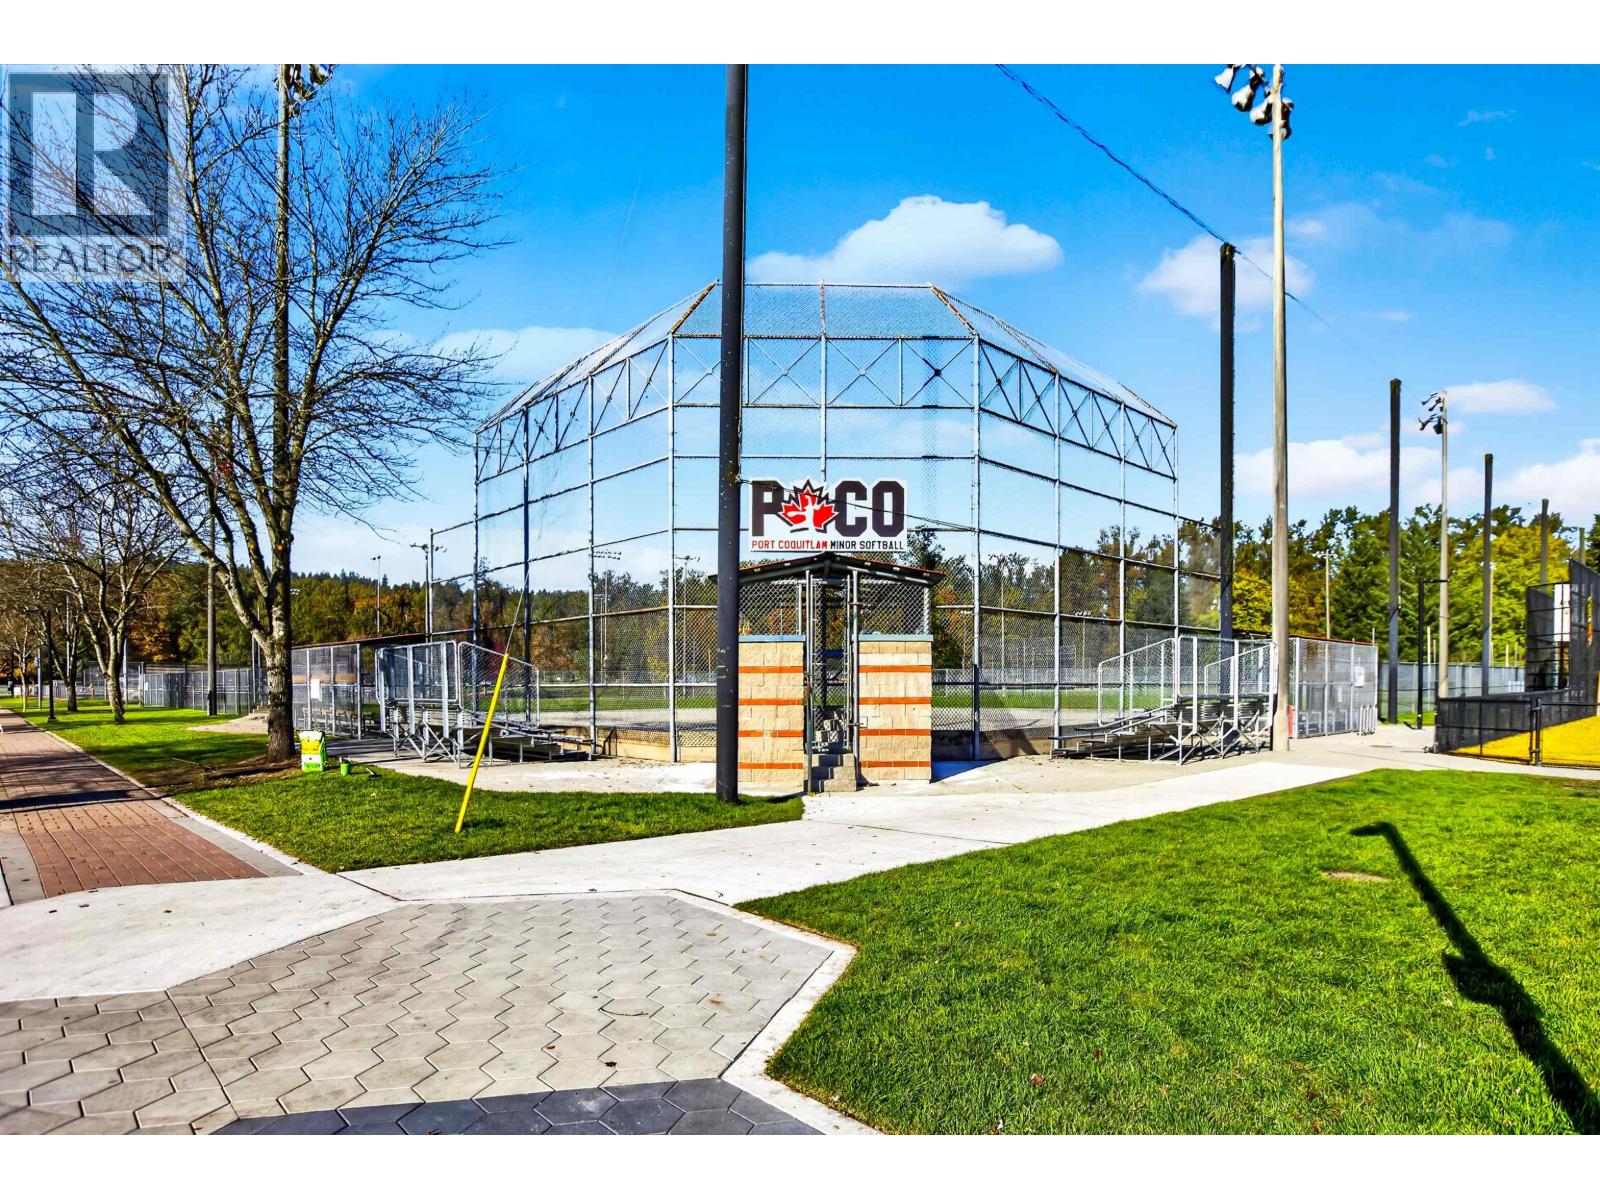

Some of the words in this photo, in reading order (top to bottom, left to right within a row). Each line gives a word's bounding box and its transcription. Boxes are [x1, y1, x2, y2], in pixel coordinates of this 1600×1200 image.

[752, 540, 775, 550] PORT
[779, 540, 827, 550] COQUITLAM
[830, 540, 856, 550] MINOR
[860, 540, 903, 550] SOFTBALL
